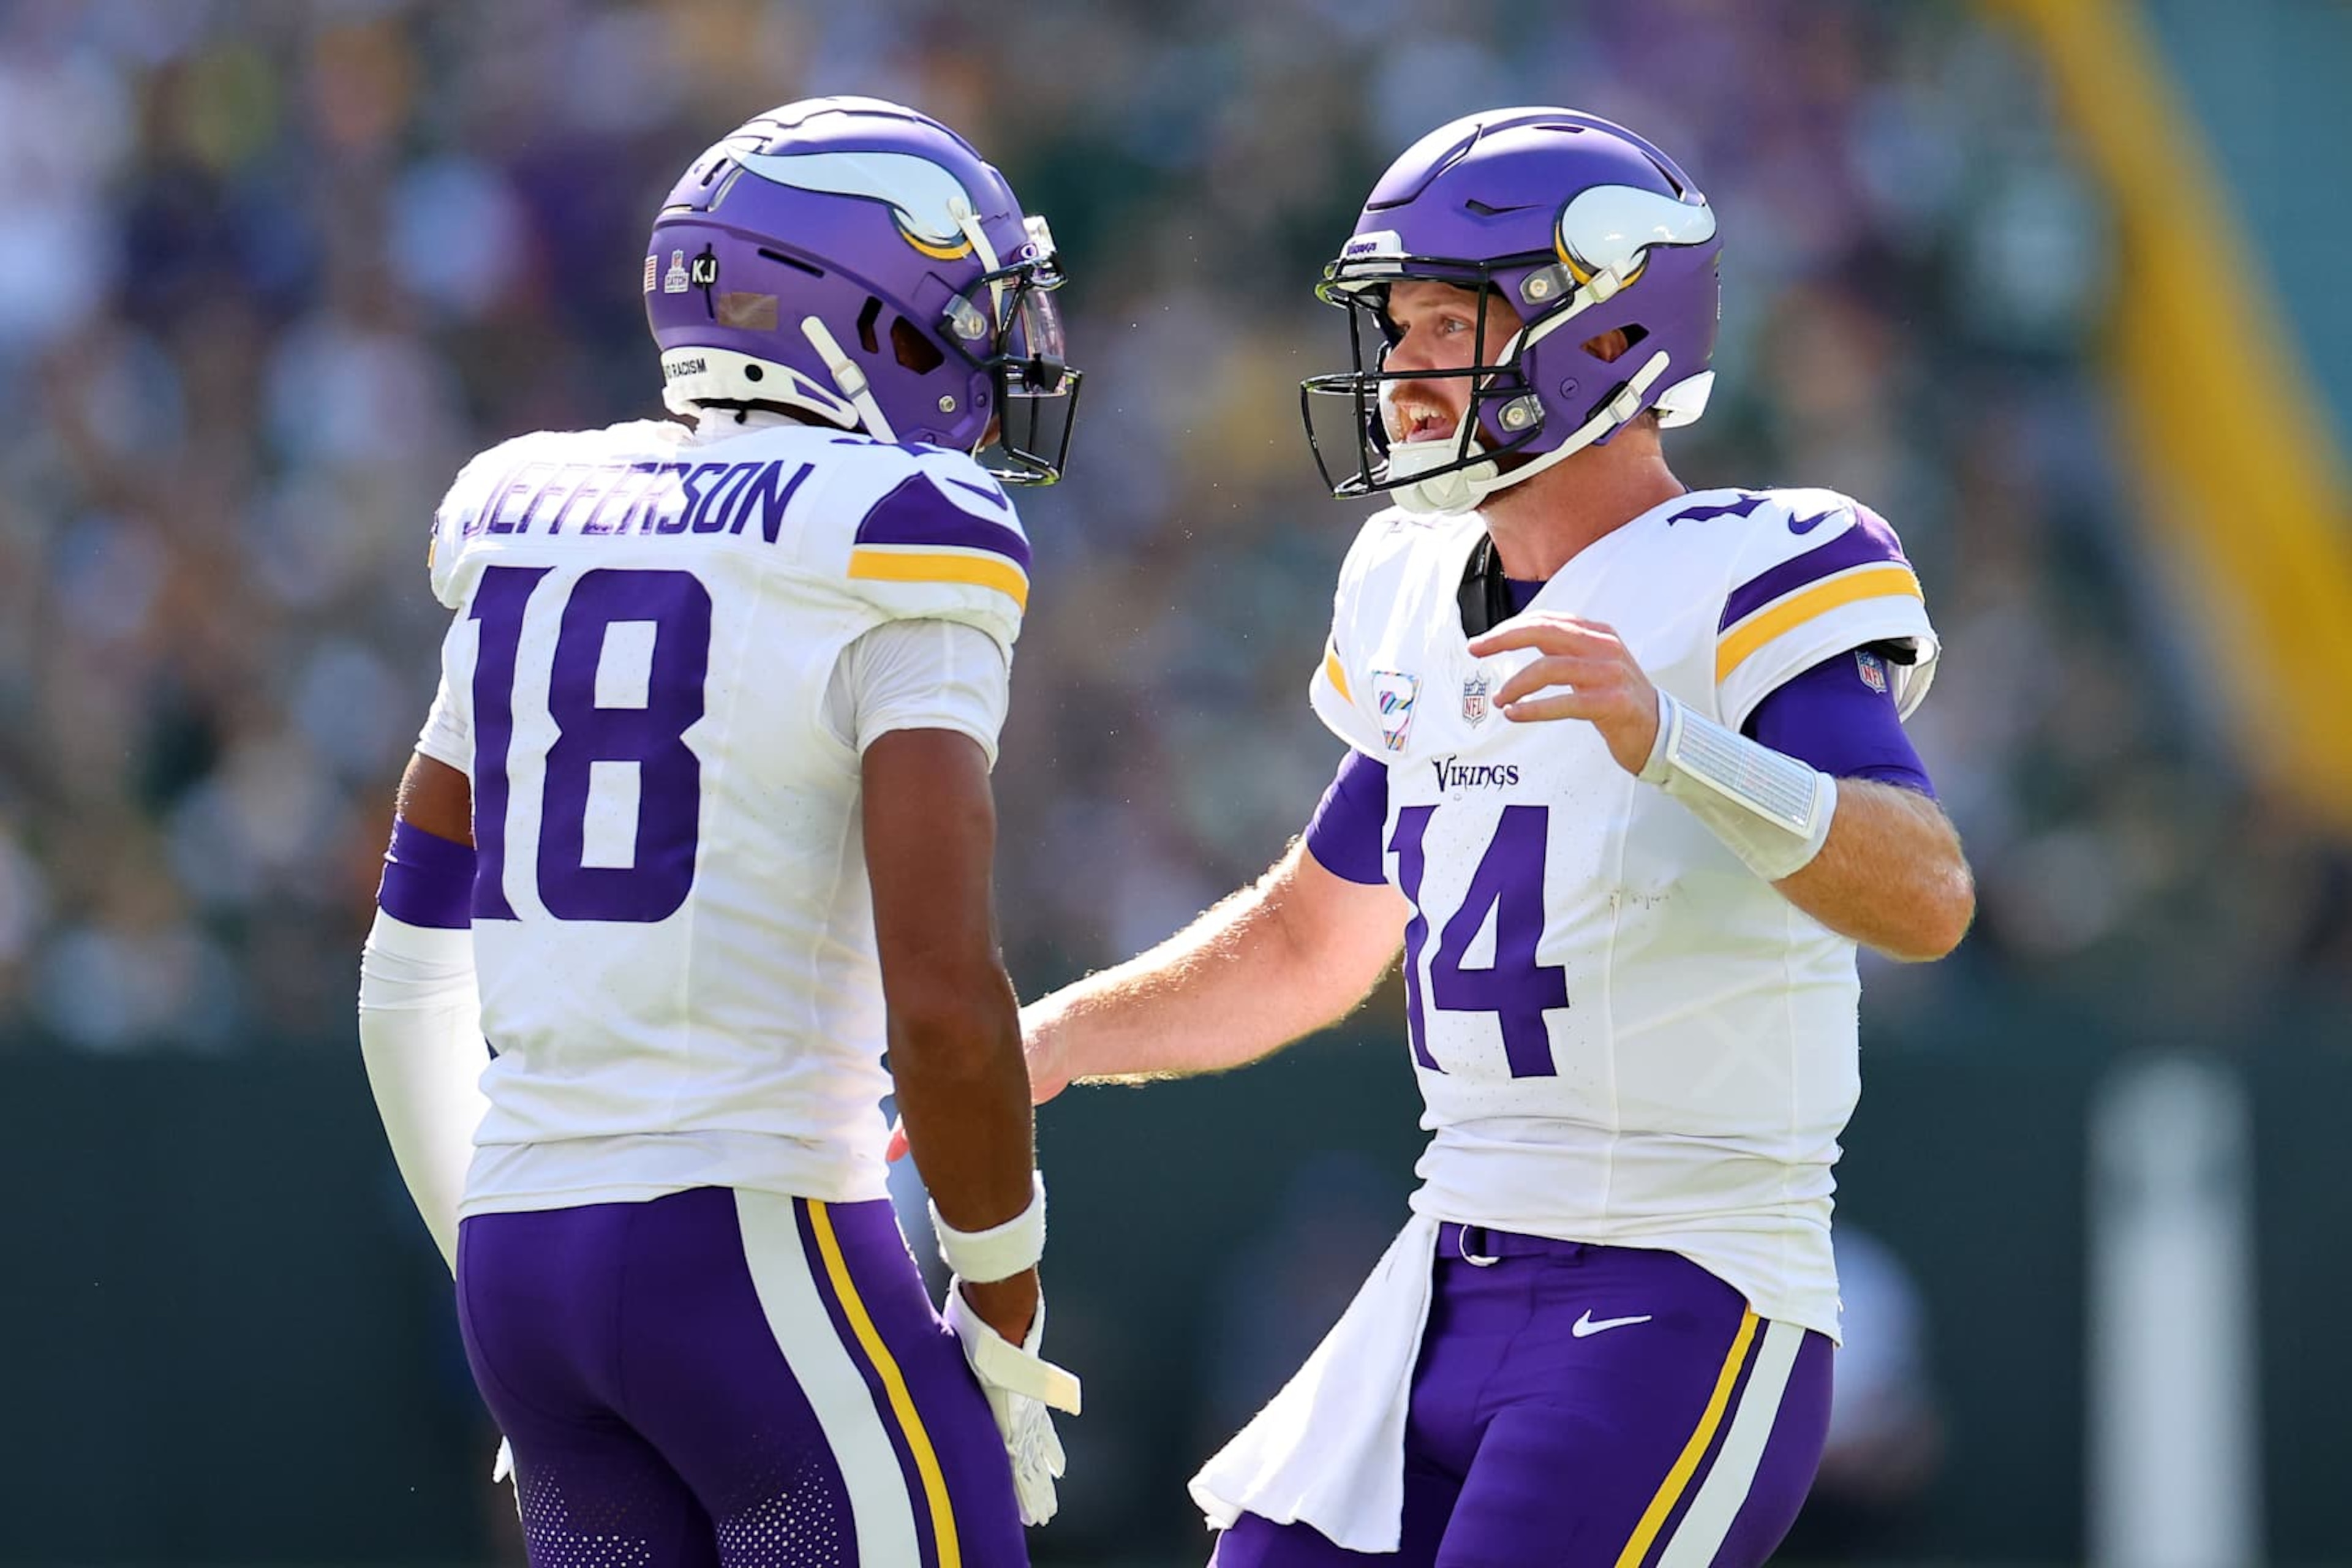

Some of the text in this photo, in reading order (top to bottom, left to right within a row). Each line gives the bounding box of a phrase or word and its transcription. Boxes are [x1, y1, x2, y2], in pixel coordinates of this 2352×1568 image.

[692, 258, 716, 283] KJ
[671, 358, 707, 378] RACISM
[462, 459, 815, 544] JEFFERSON
[1464, 697, 1485, 718] NFL
[467, 565, 712, 923] 18
[1387, 804, 1570, 1079] 14
